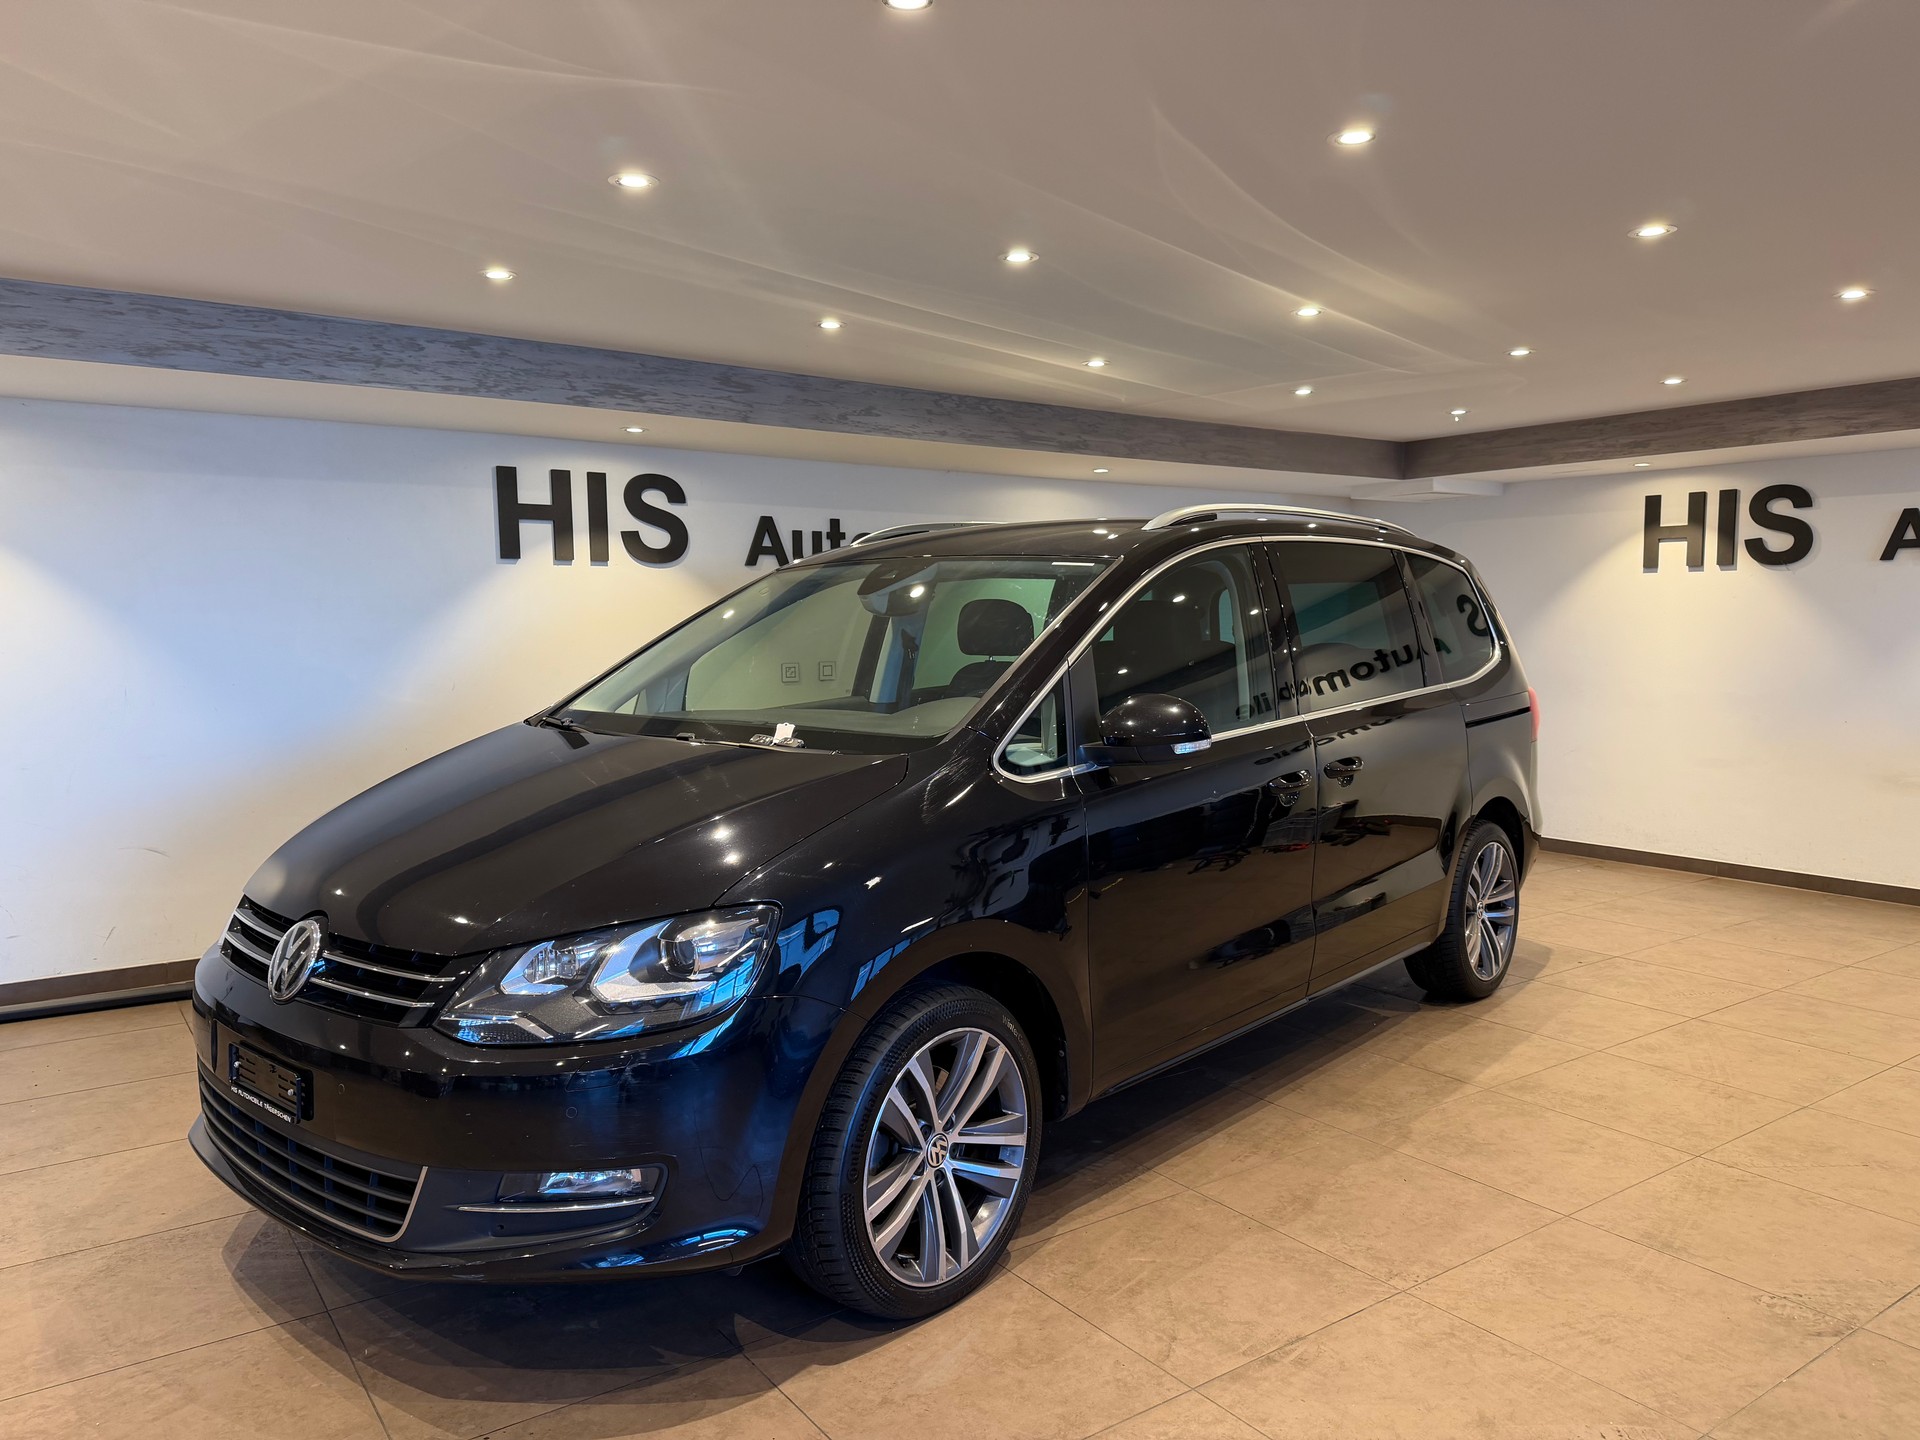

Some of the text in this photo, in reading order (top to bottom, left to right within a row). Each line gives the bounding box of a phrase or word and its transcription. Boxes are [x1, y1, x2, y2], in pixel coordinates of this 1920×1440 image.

[496, 466, 873, 566] HIS Aut
[1643, 484, 1814, 568] HIS
[230, 1085, 238, 1094] HIS
[237, 1089, 264, 1108] AUTOMOBILE
